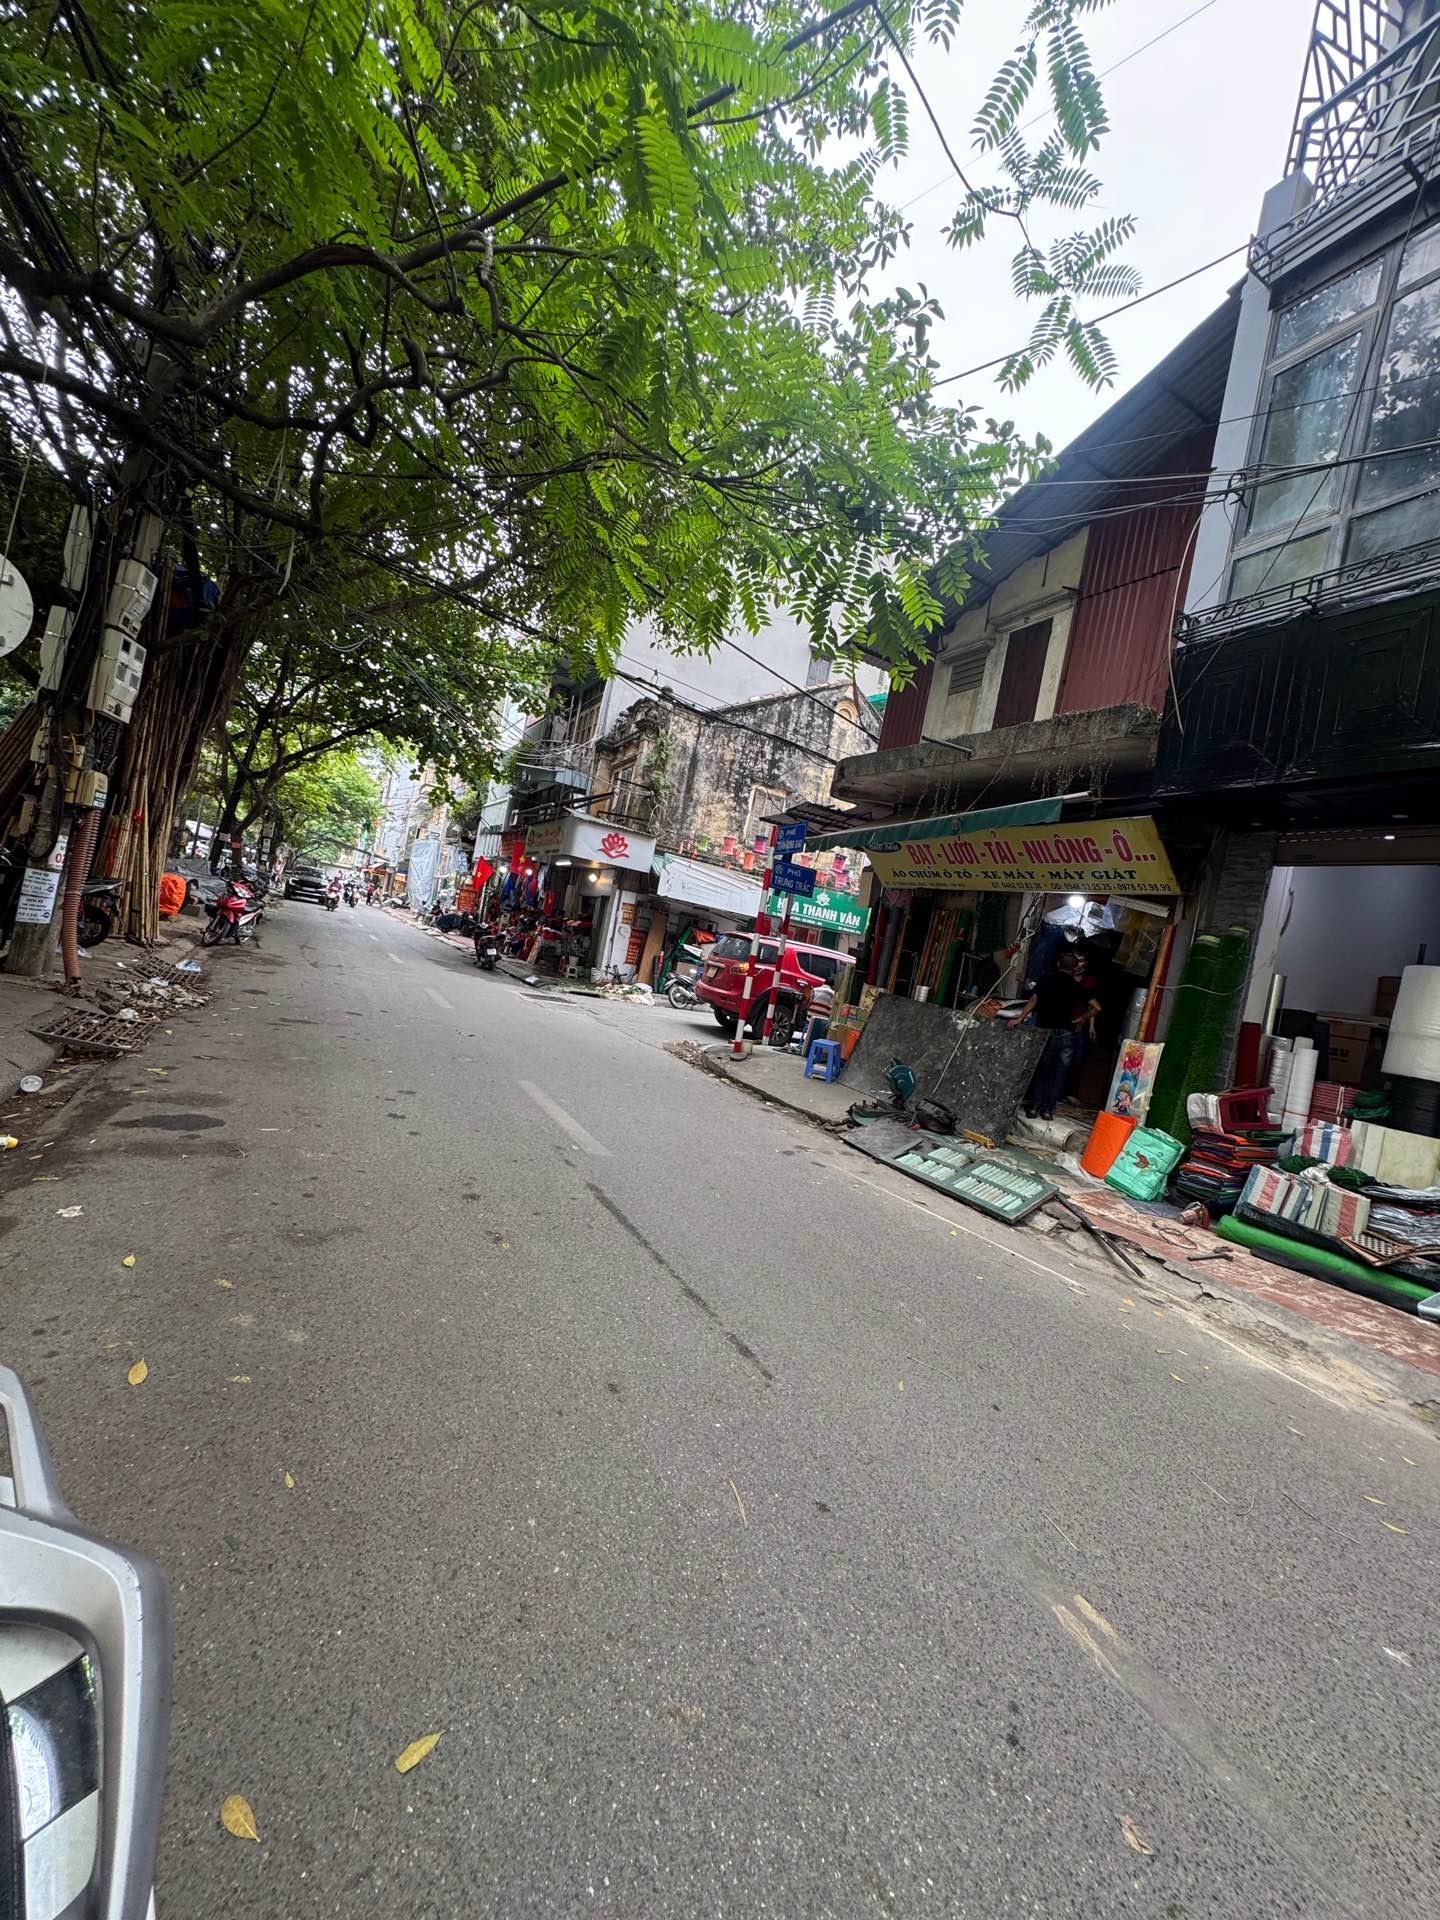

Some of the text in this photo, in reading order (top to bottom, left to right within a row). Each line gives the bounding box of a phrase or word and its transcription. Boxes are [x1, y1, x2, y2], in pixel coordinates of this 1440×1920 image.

[983, 830, 1018, 865] TẢI
[1022, 832, 1104, 864] NILÔNG
[803, 903, 837, 922] THANH
[840, 911, 860, 926] VÂN
